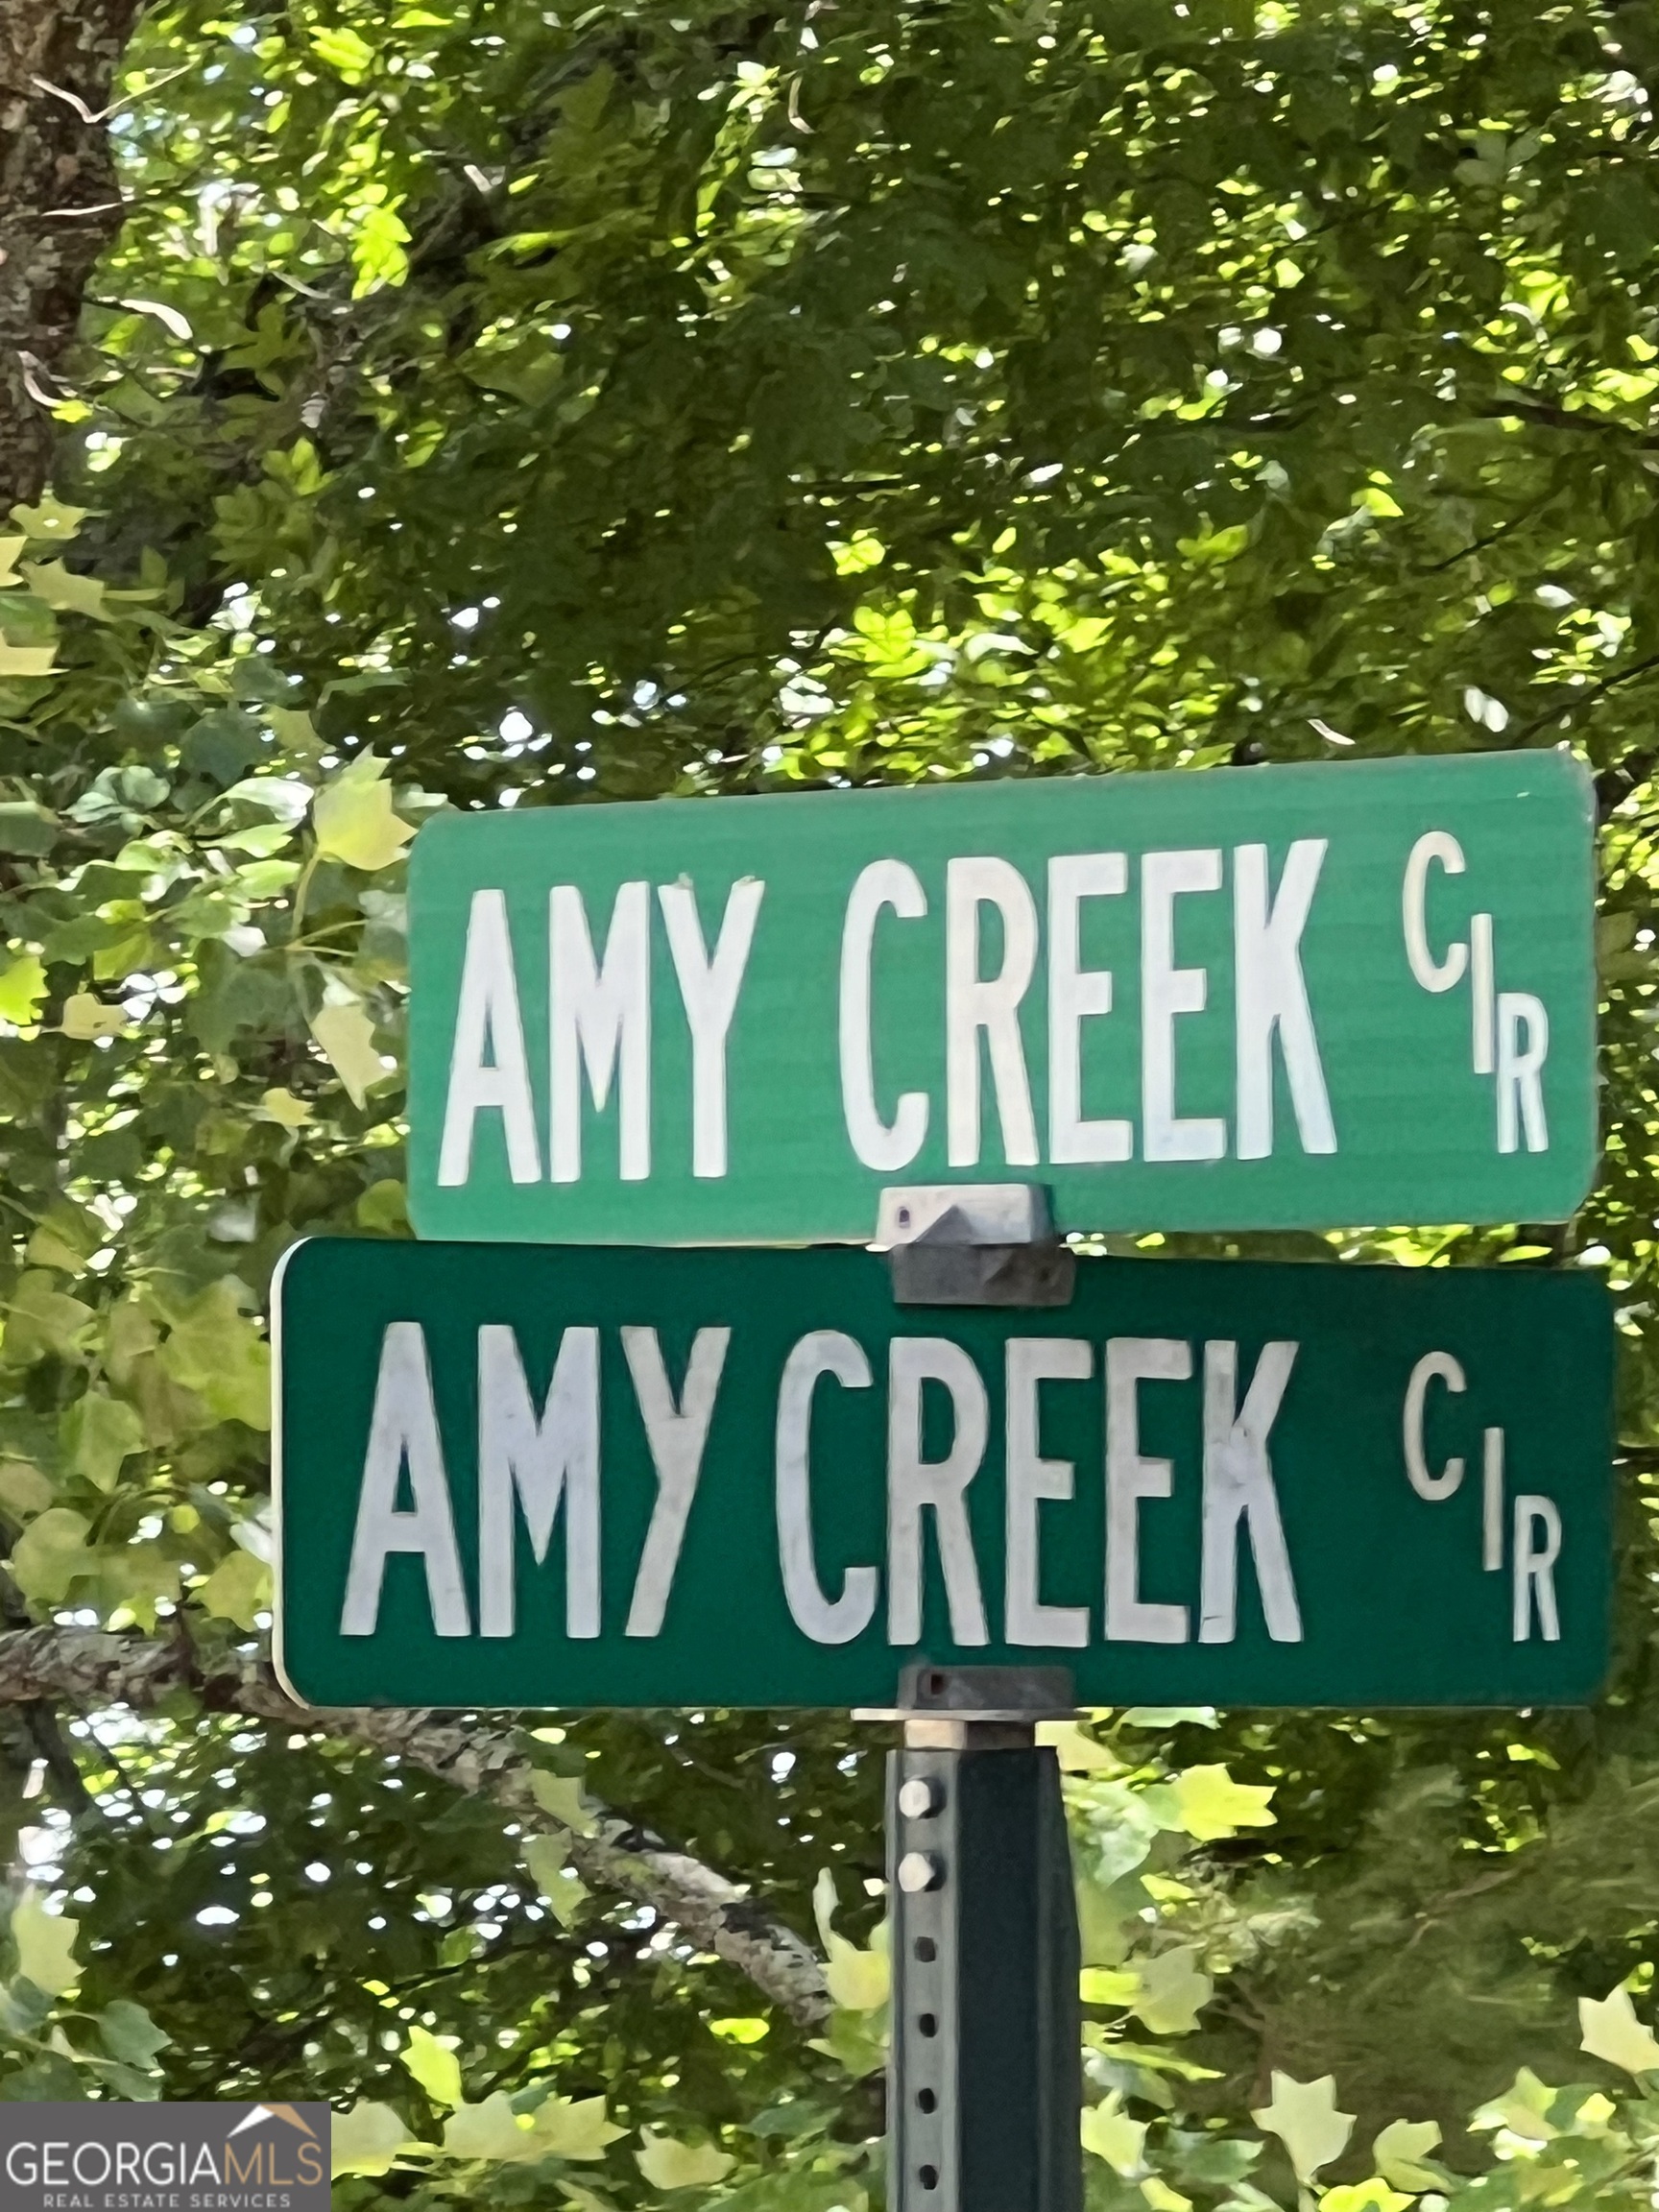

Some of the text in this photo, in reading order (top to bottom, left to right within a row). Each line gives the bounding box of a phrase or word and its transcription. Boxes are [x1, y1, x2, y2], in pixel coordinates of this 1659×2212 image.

[438, 830, 1549, 1186] AMY CREEK CIR
[339, 1322, 1562, 1647] AMY CREEK CIR
